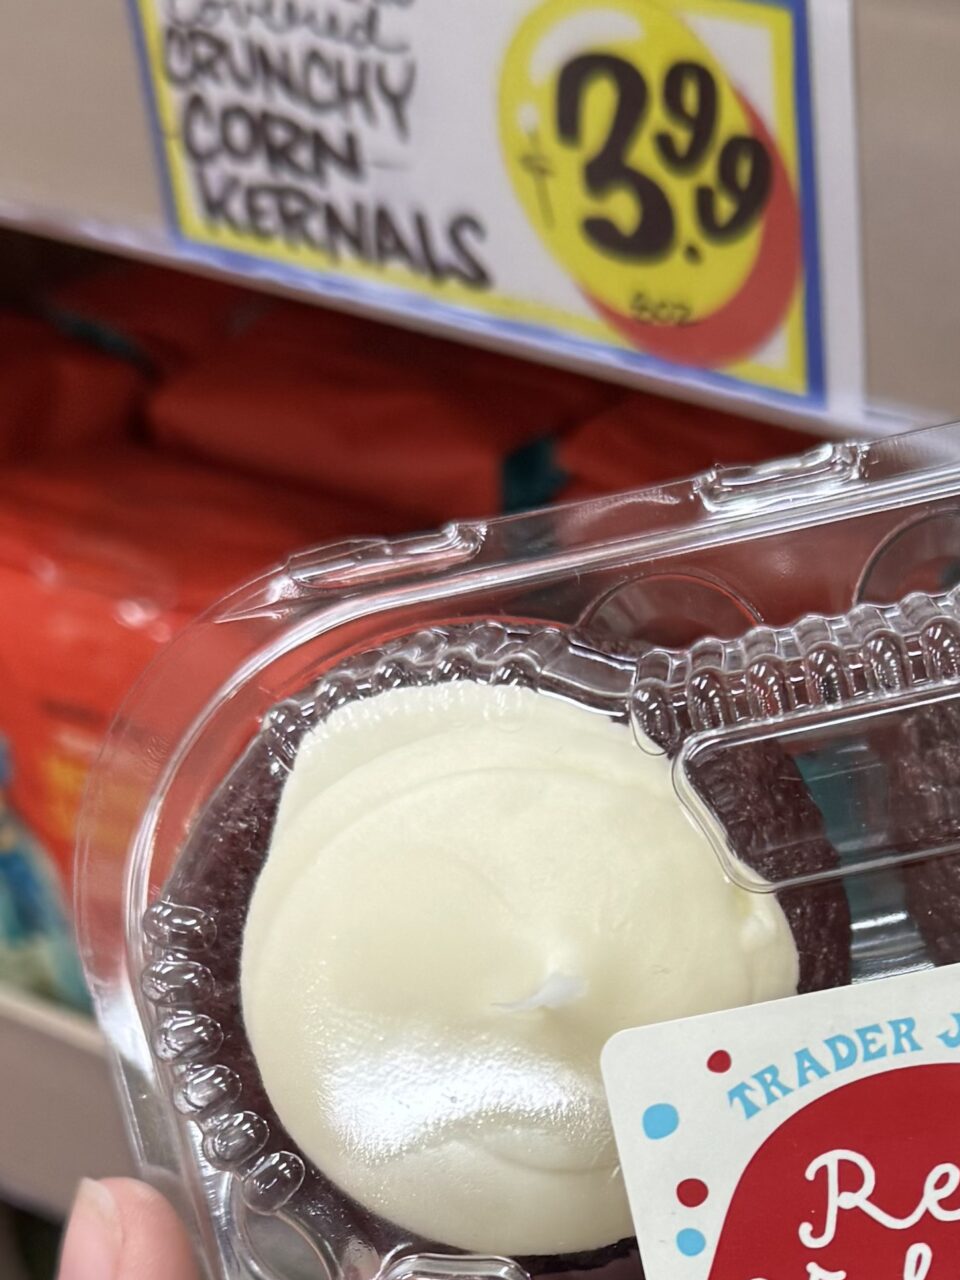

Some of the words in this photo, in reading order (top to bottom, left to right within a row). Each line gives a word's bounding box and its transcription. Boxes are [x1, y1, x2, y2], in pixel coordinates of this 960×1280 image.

[165, 26, 416, 144] CRUNCHY
[183, 93, 362, 186] CORN
[196, 178, 493, 289] KERNALS
[727, 1017, 923, 1119] TRADER
